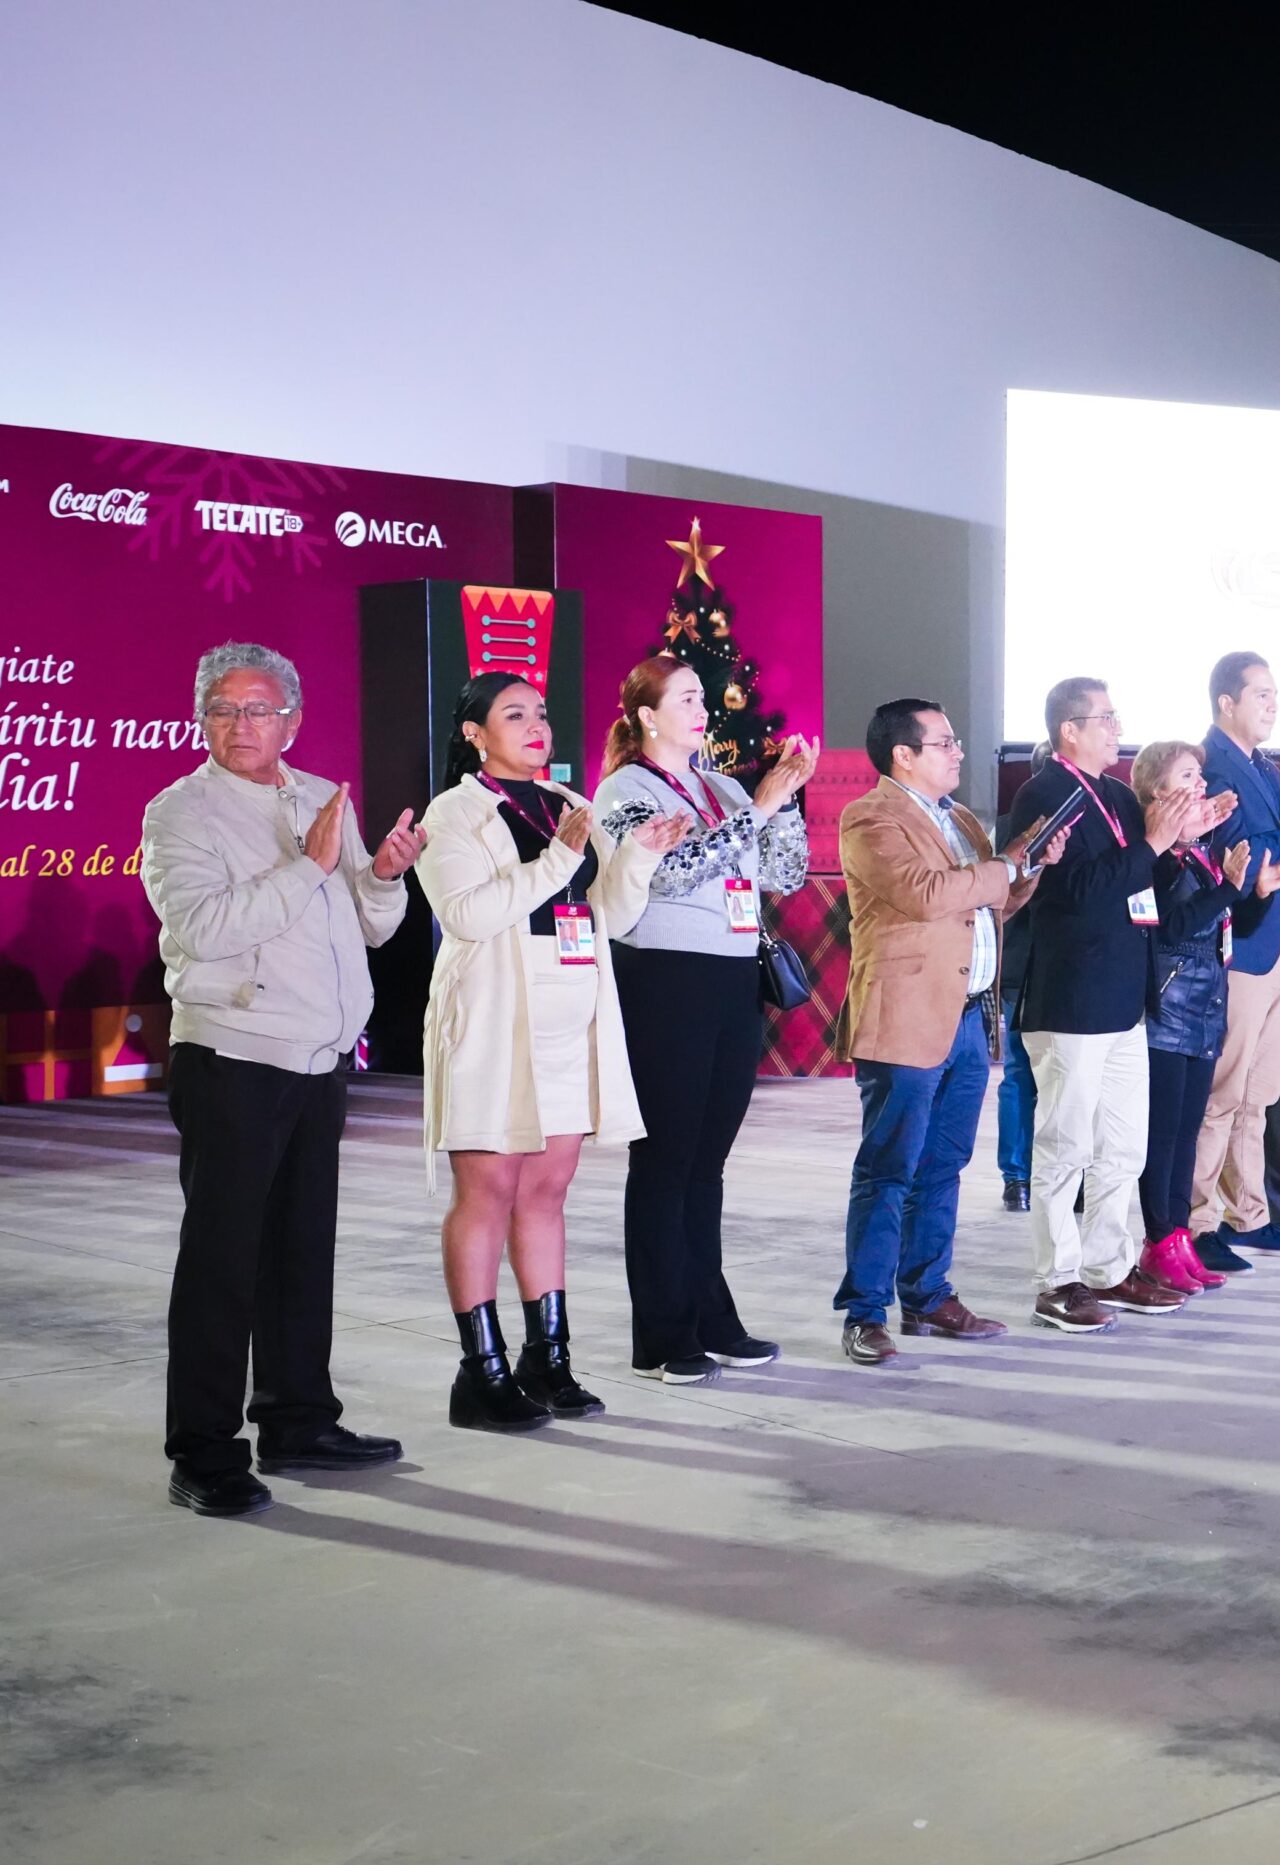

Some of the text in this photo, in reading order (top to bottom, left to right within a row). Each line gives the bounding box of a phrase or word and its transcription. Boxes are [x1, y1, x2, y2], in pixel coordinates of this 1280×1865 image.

[49, 482, 149, 526] Coca-Cola
[194, 500, 287, 537] TECATE
[368, 518, 445, 549] MEGA
[0, 646, 75, 688] iate
[111, 718, 211, 751] navi
[0, 844, 37, 877] al
[38, 848, 76, 877] 28
[82, 844, 116, 876] de
